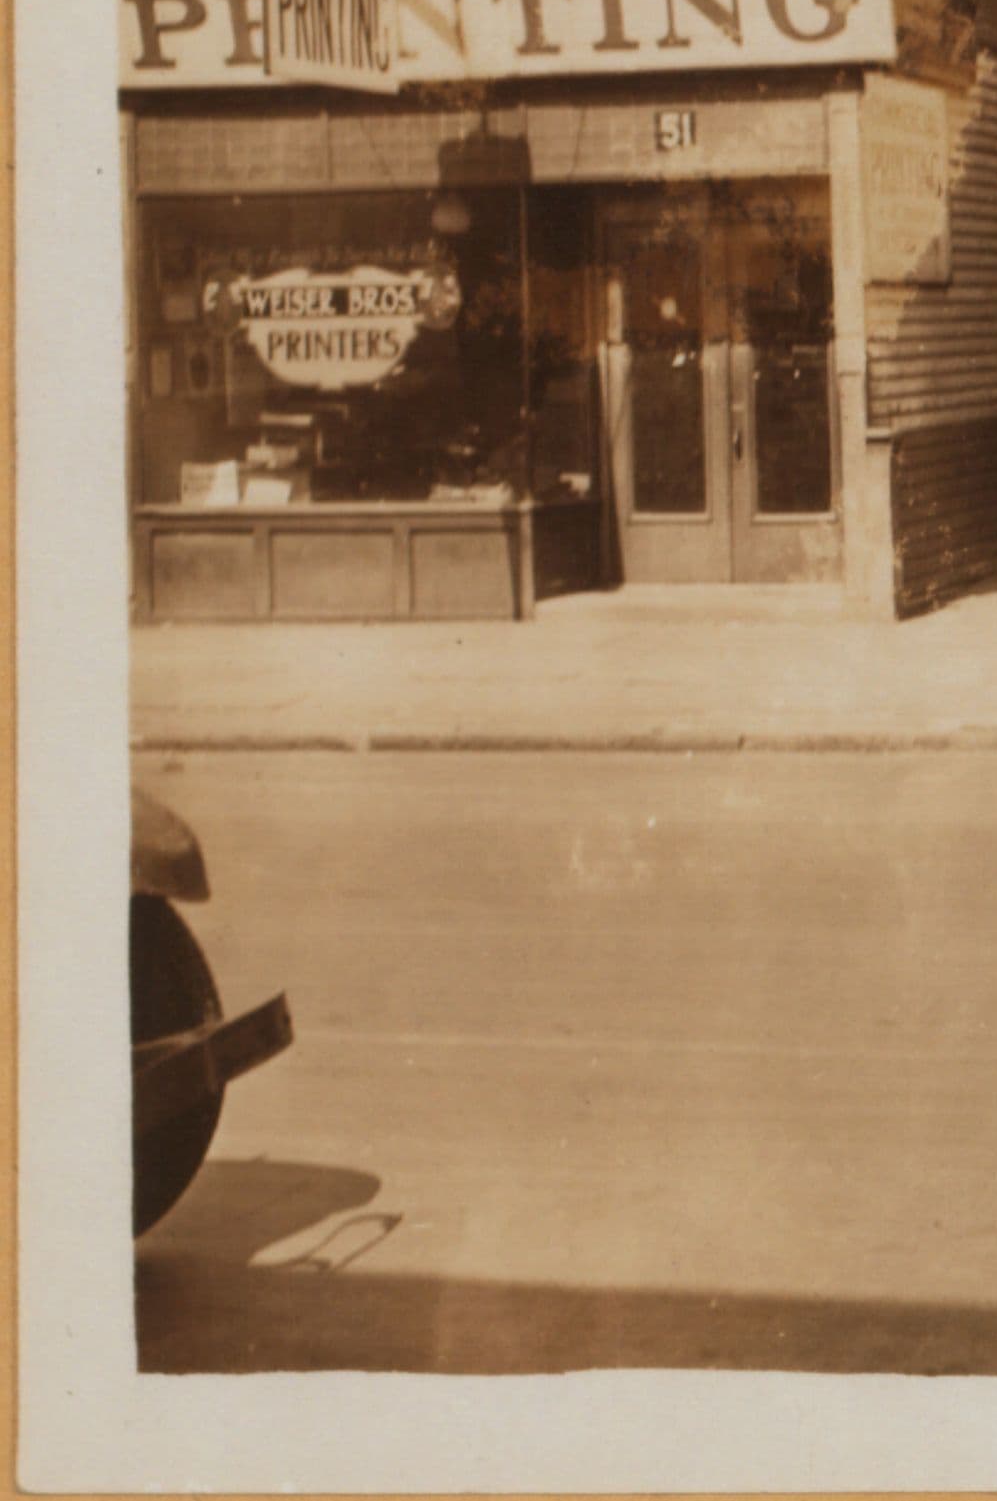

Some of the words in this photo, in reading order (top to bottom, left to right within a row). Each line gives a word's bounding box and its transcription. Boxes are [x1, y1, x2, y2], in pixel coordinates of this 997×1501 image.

[659, 110, 694, 151] 51
[248, 284, 336, 317] WEISER
[266, 327, 401, 362] PRINTERS
